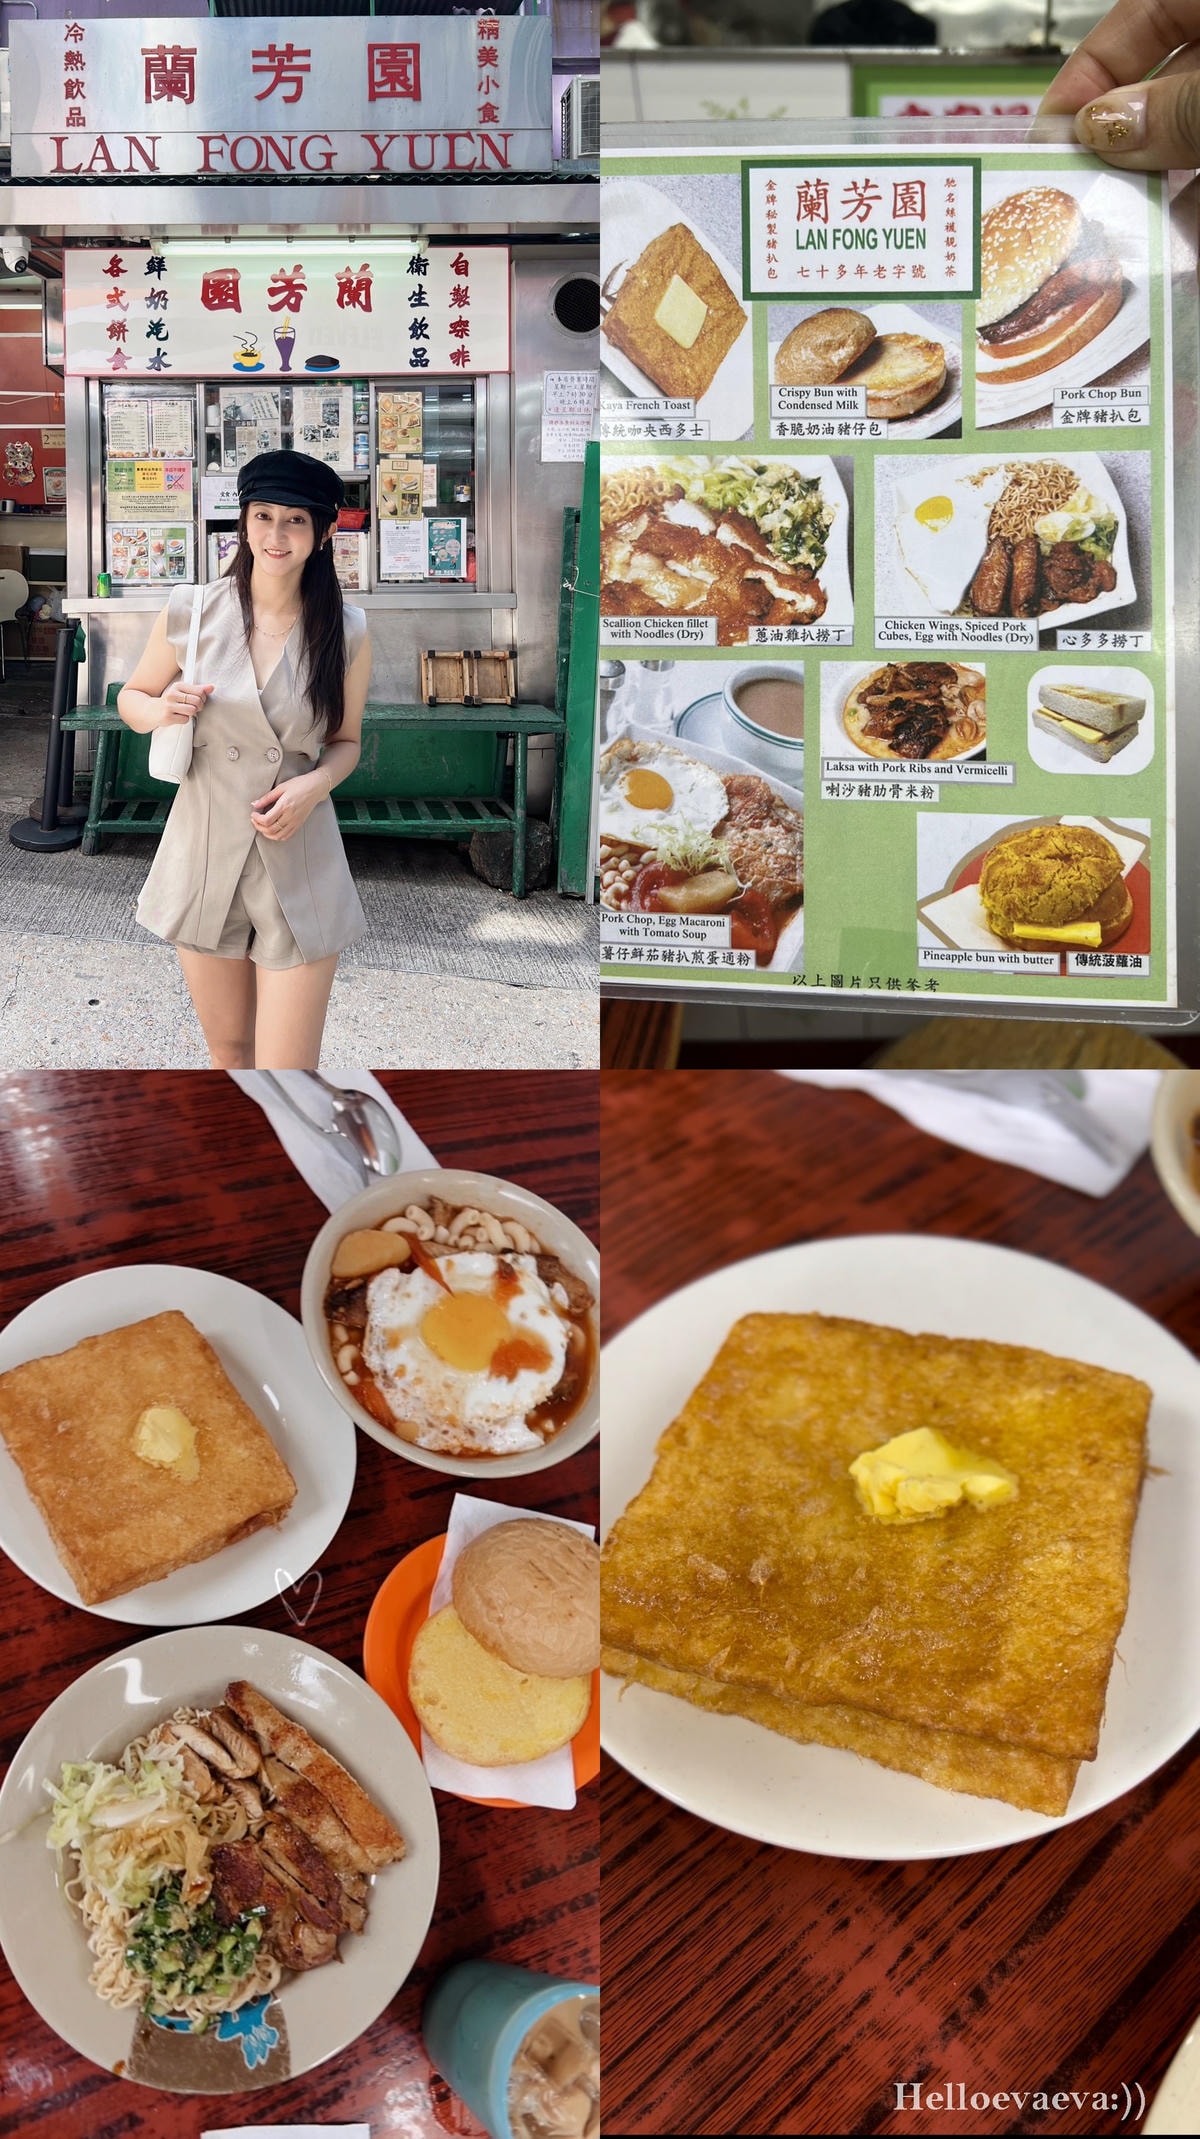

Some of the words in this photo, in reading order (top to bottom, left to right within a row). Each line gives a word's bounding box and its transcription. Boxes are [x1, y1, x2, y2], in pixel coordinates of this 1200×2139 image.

[63, 22, 87, 129] 冷熱飲品
[140, 42, 423, 105] 蘭芳園
[476, 17, 500, 124] 精美小食
[49, 134, 161, 174] LAN
[196, 133, 339, 173] FONG
[360, 131, 512, 171] YUEN
[796, 178, 927, 224] 蘭芳園
[765, 179, 779, 279] 金牌秘製豬扒包
[944, 177, 958, 278] 馳名絲襪靚奶茶
[796, 228, 828, 250] LAN
[832, 228, 878, 250] FONG
[882, 227, 927, 249] YUEN
[796, 263, 927, 280] 七十多年老字號
[102, 253, 133, 371] 各式餅食
[143, 255, 172, 371] 鮮奶汽水
[406, 253, 430, 368] 衛生飲品
[778, 388, 811, 399] Crispy
[814, 388, 834, 397] Bun
[836, 388, 858, 397] with
[1060, 390, 1086, 400] Pork
[1088, 389, 1116, 400] Chop
[1120, 388, 1142, 398] Bun
[626, 400, 660, 410] French
[663, 400, 690, 410] Toast
[778, 400, 832, 410] Condensed
[836, 400, 858, 410] Milk
[1060, 408, 1142, 424] 金牌豬扒包
[776, 422, 882, 436] 香脆奶油豬仔包
[602, 618, 641, 628] Scallion
[644, 618, 684, 628] Chicken
[686, 618, 708, 628] fillet
[885, 620, 926, 630] Chicken
[928, 620, 963, 633] Wings,
[965, 622, 1000, 633] Spiced
[1002, 622, 1026, 632] Pork
[610, 629, 632, 639] with
[634, 629, 674, 639] Noodles
[676, 629, 704, 640] (Dry)
[878, 631, 912, 642] Cubes,
[915, 632, 934, 644] Egg
[936, 632, 958, 642] with
[961, 632, 1002, 642] Noodles
[1005, 633, 1034, 645] (Dry)
[1062, 632, 1144, 649] 心多多撈丁
[826, 762, 855, 772] Laksa
[858, 762, 879, 772] with
[882, 763, 906, 773] Pork
[910, 764, 932, 774] Ribs
[934, 765, 953, 774] and
[956, 765, 1008, 776] Vermicelli
[826, 782, 934, 800] 喇沙豬肋骨米粉
[602, 914, 624, 923] Pork
[626, 914, 656, 926] Chop,
[658, 916, 677, 927] Egg
[680, 916, 726, 928] Macaroni
[620, 927, 640, 936] with
[643, 928, 680, 938] Tomato
[682, 930, 707, 941] Soup
[602, 946, 751, 966] 薯仔鮮茄豬扒煎蛋通粉
[923, 950, 973, 963] Pineapple
[976, 953, 995, 963] bun
[998, 954, 1020, 964] with
[1023, 955, 1055, 966] butter
[1075, 953, 1142, 968] 傳統菠蘿油
